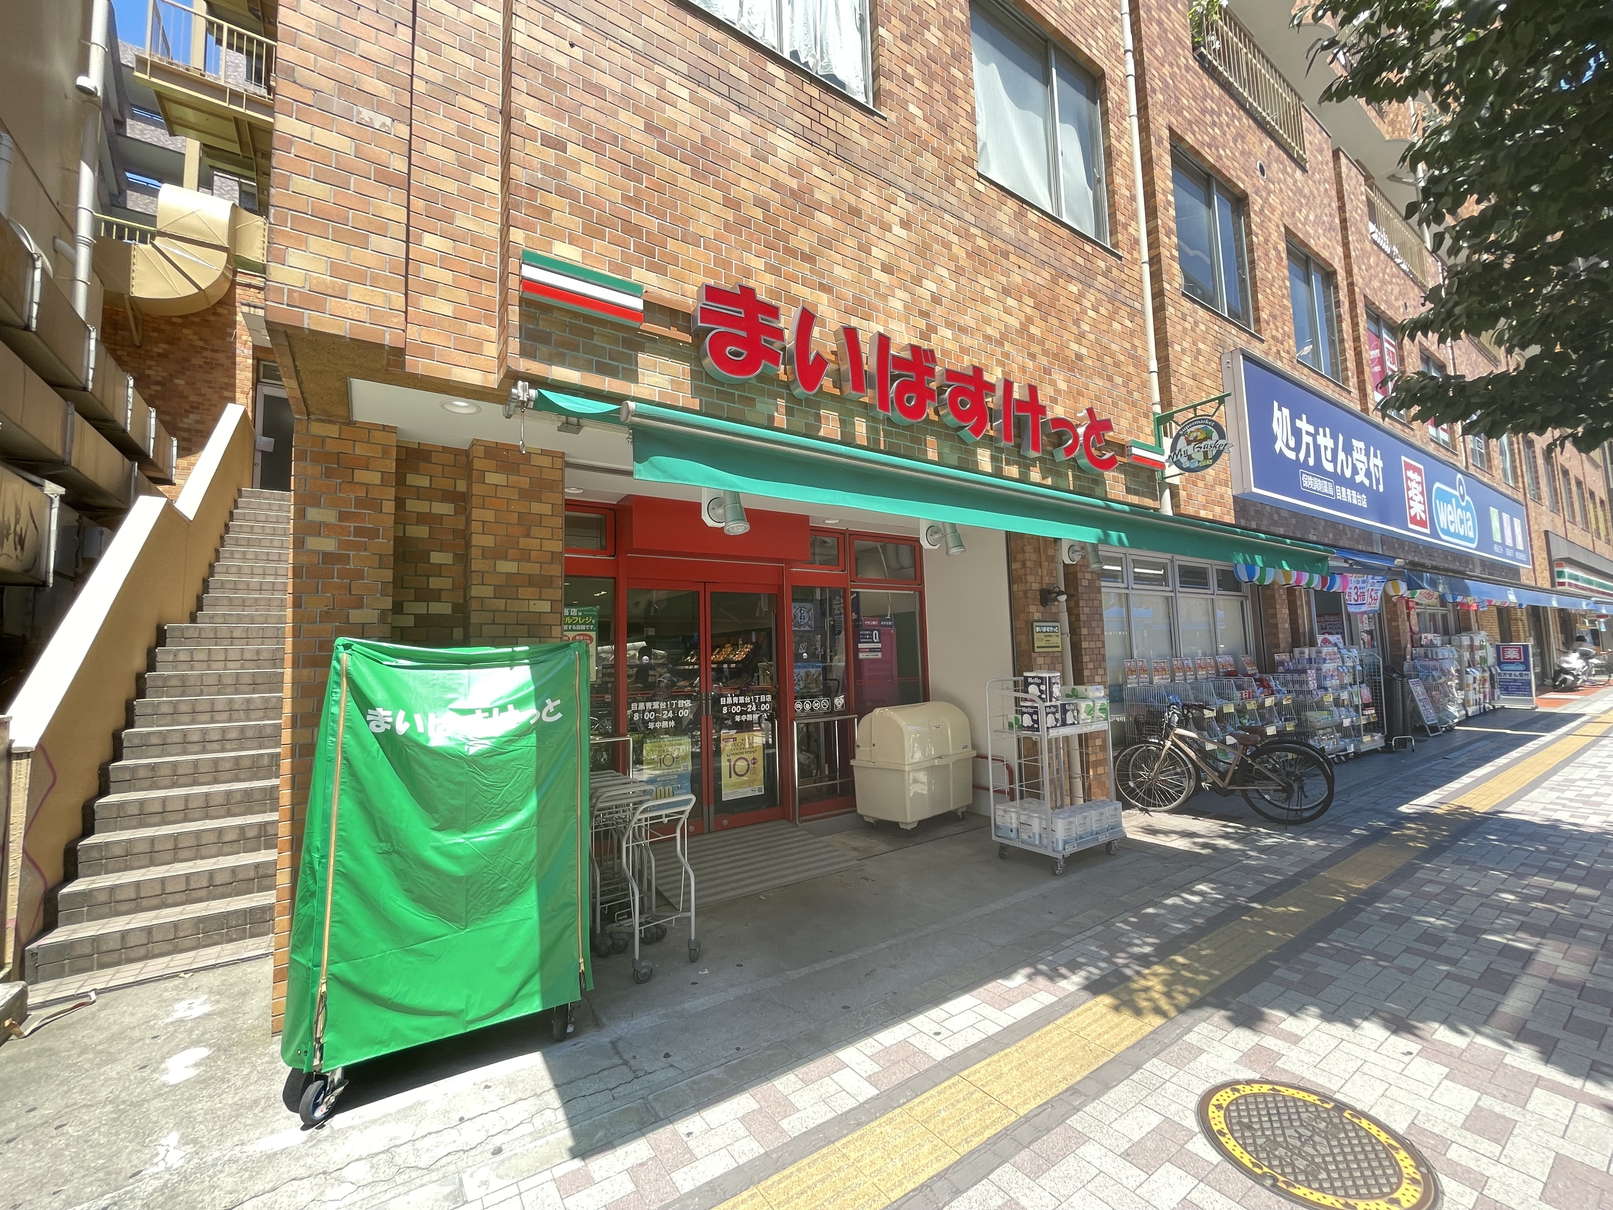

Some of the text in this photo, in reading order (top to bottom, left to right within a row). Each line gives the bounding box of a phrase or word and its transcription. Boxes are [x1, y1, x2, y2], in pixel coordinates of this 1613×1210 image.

[698, 282, 1120, 473] まいばすけっと
[1271, 400, 1384, 493] 処方せん受付
[1406, 467, 1426, 521] 薬
[1436, 497, 1475, 538] welcia
